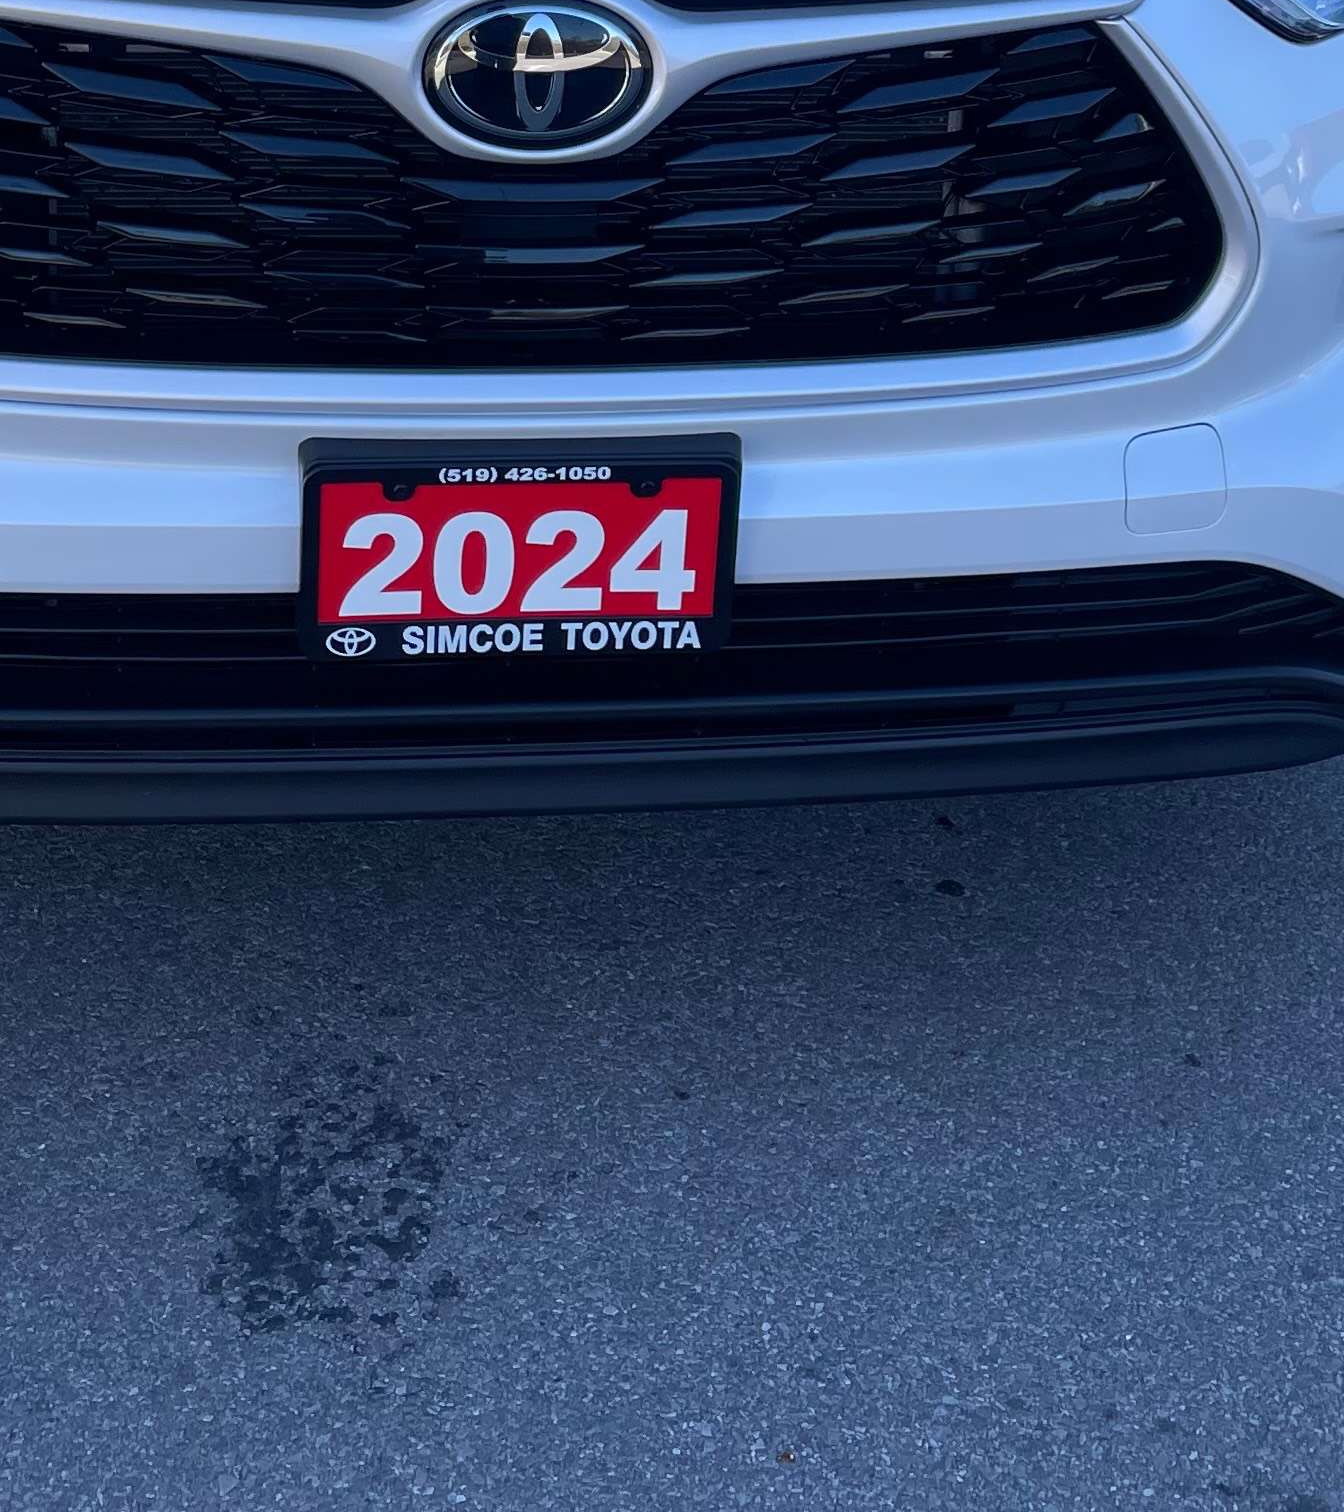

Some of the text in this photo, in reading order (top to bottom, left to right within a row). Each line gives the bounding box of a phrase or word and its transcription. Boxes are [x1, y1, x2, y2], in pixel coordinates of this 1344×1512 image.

[438, 466, 611, 483] (519) 426-1050
[338, 508, 696, 617] 2024
[401, 621, 702, 655] SIMCOE TOYOTA
